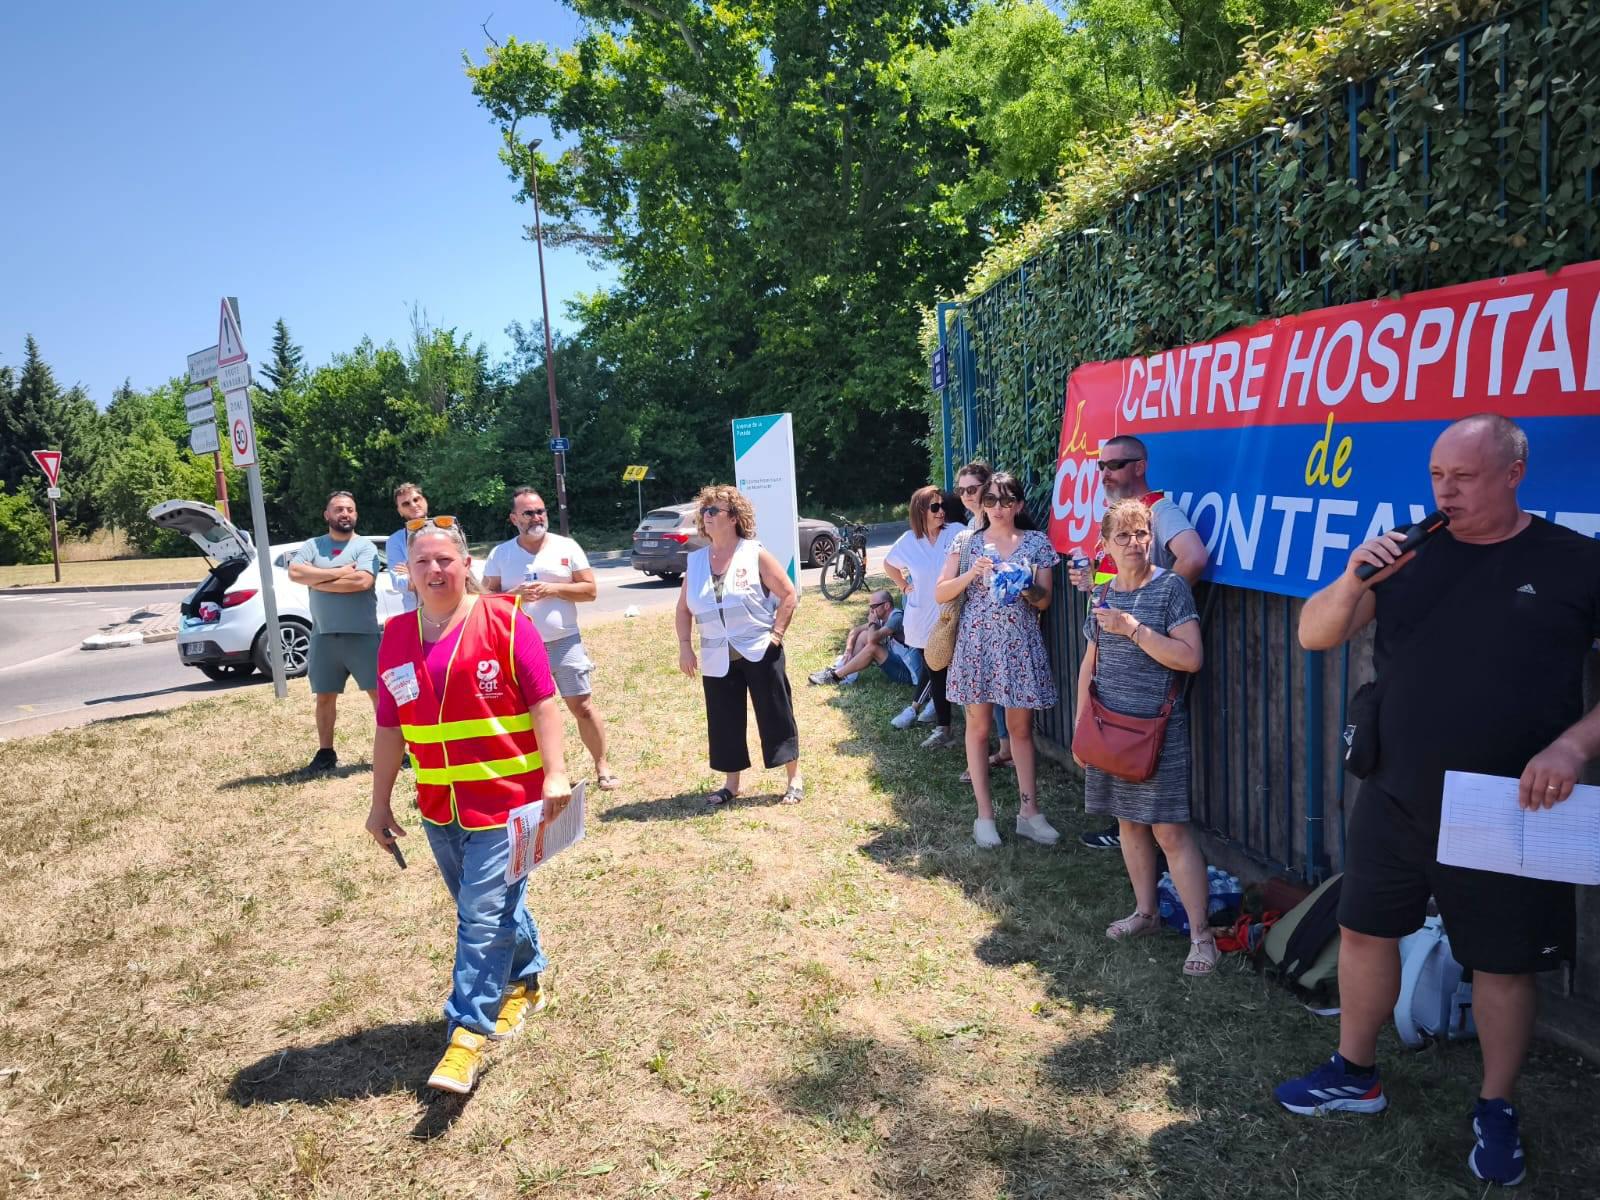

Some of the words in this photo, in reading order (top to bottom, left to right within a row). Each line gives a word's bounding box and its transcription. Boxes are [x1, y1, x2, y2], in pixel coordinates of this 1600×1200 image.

[1122, 334, 1273, 421] CENTRE
[236, 429, 246, 445] 30
[1062, 399, 1101, 457] la
[1305, 412, 1353, 488] de
[479, 679, 498, 692] cgt
